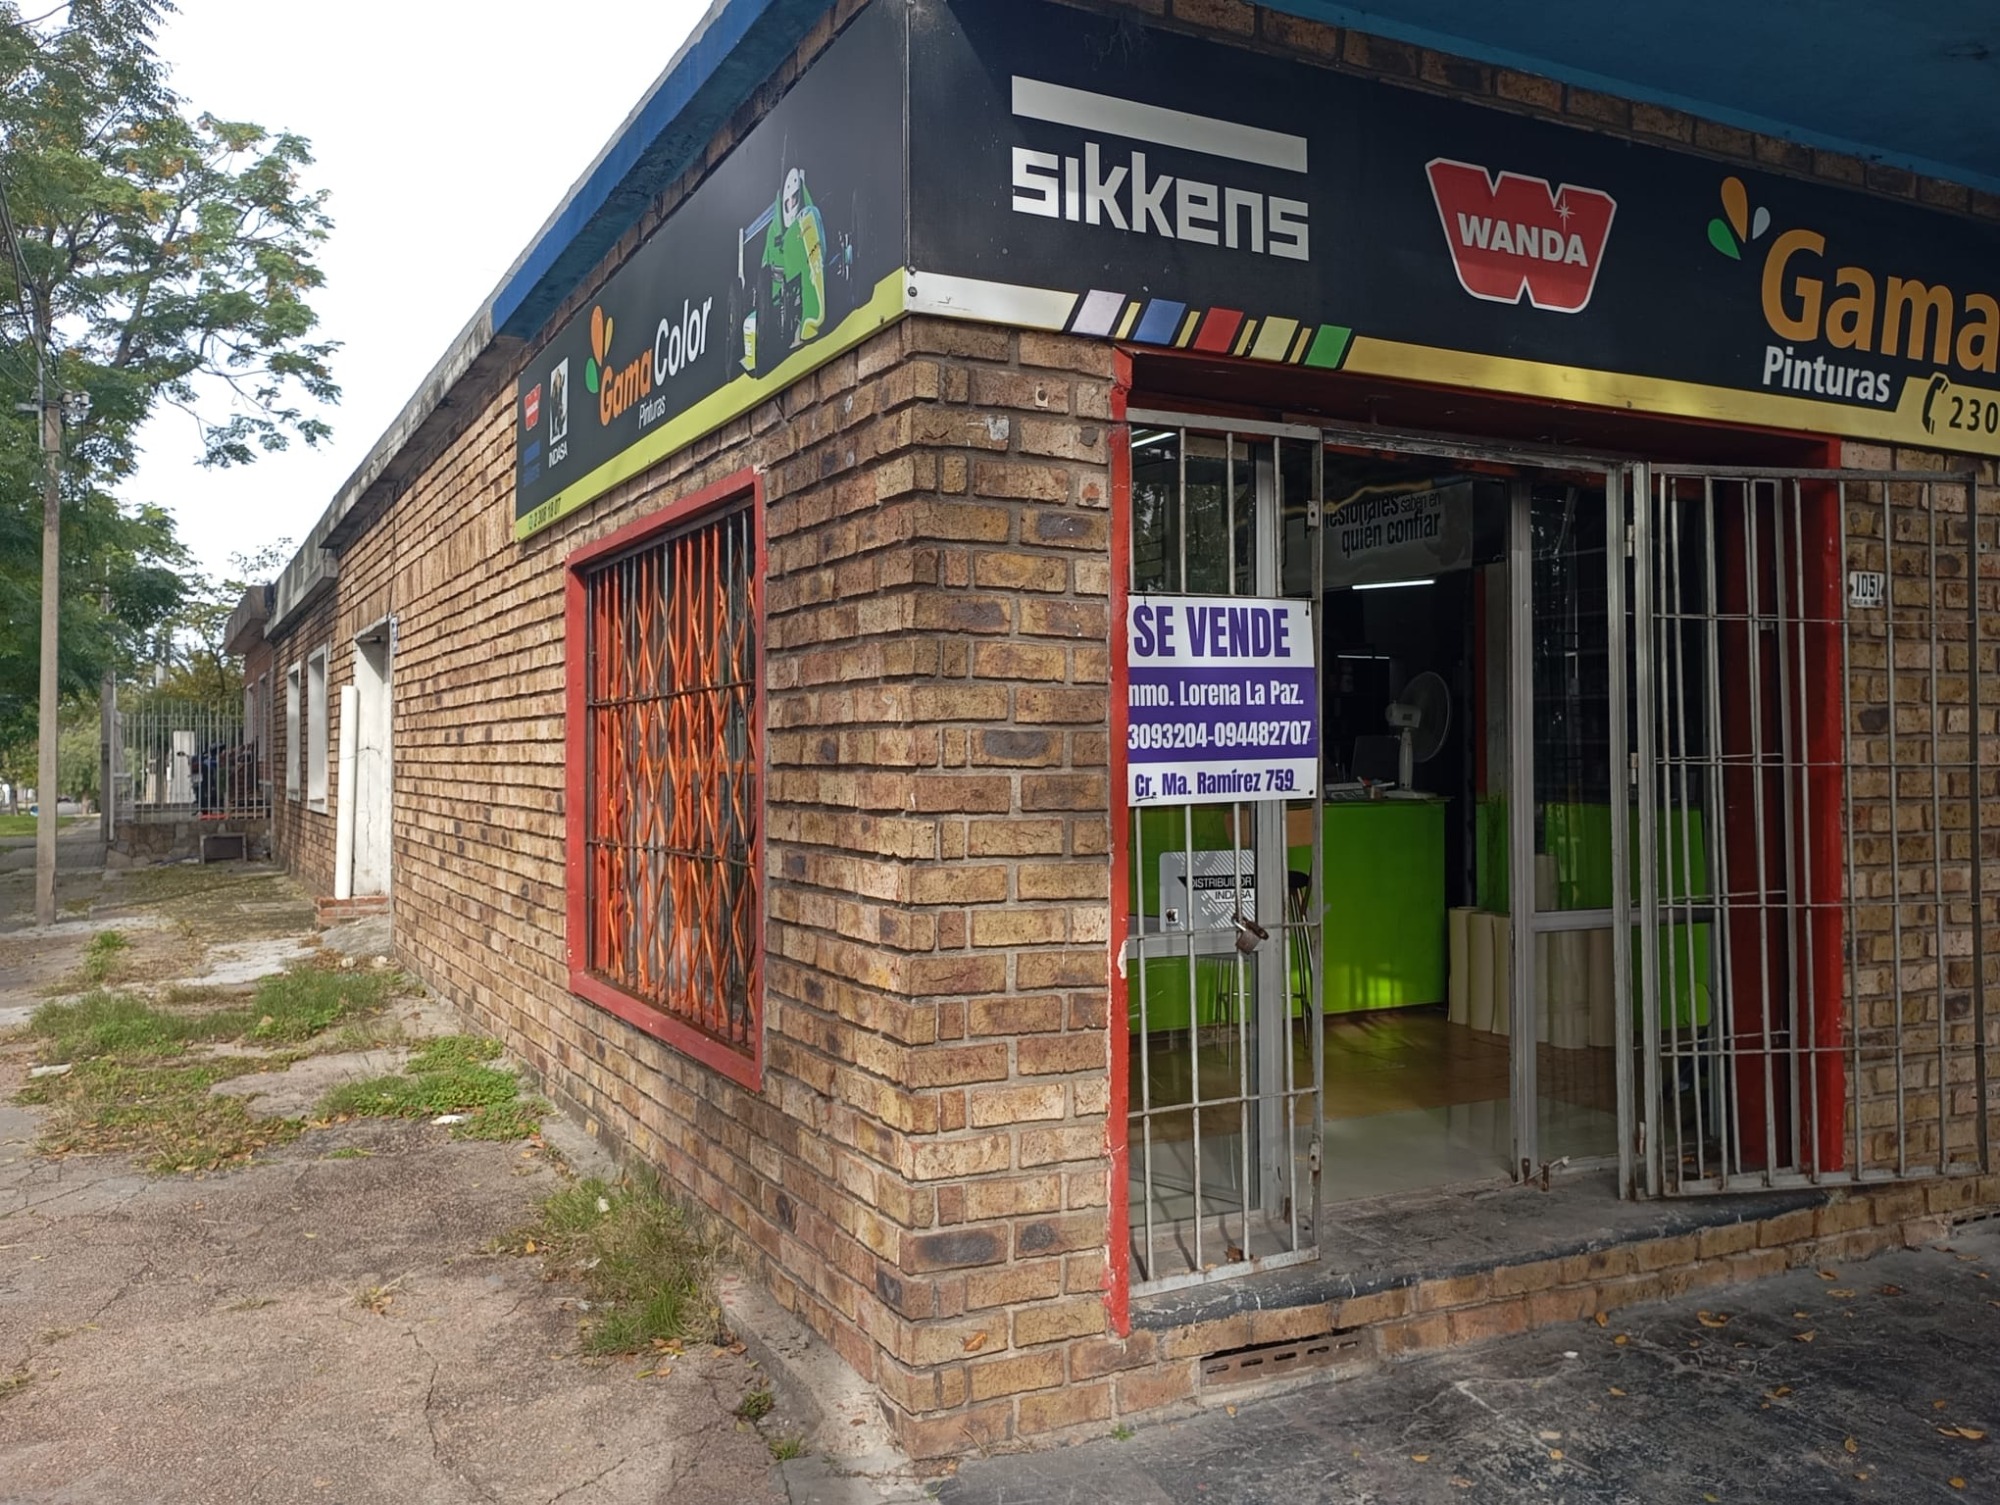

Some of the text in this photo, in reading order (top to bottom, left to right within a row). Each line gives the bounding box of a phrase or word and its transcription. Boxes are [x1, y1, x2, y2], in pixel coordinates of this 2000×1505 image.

[1012, 142, 1309, 261] sikkens
[1457, 212, 1589, 267] WANDA
[1761, 229, 2000, 373] Gama
[1762, 345, 1891, 403] Pinturas
[638, 395, 666, 429] Pinturas
[1949, 396, 2000, 434] 230
[1342, 511, 1441, 558] quien confiar
[1855, 573, 1880, 598] 1051
[1133, 605, 1291, 657] SE VENDE
[1179, 681, 1241, 706] Lorena
[1246, 680, 1265, 705] La
[1270, 680, 1304, 705] Paz.
[1135, 768, 1294, 797] Cr. Ma. Ramírez 759
